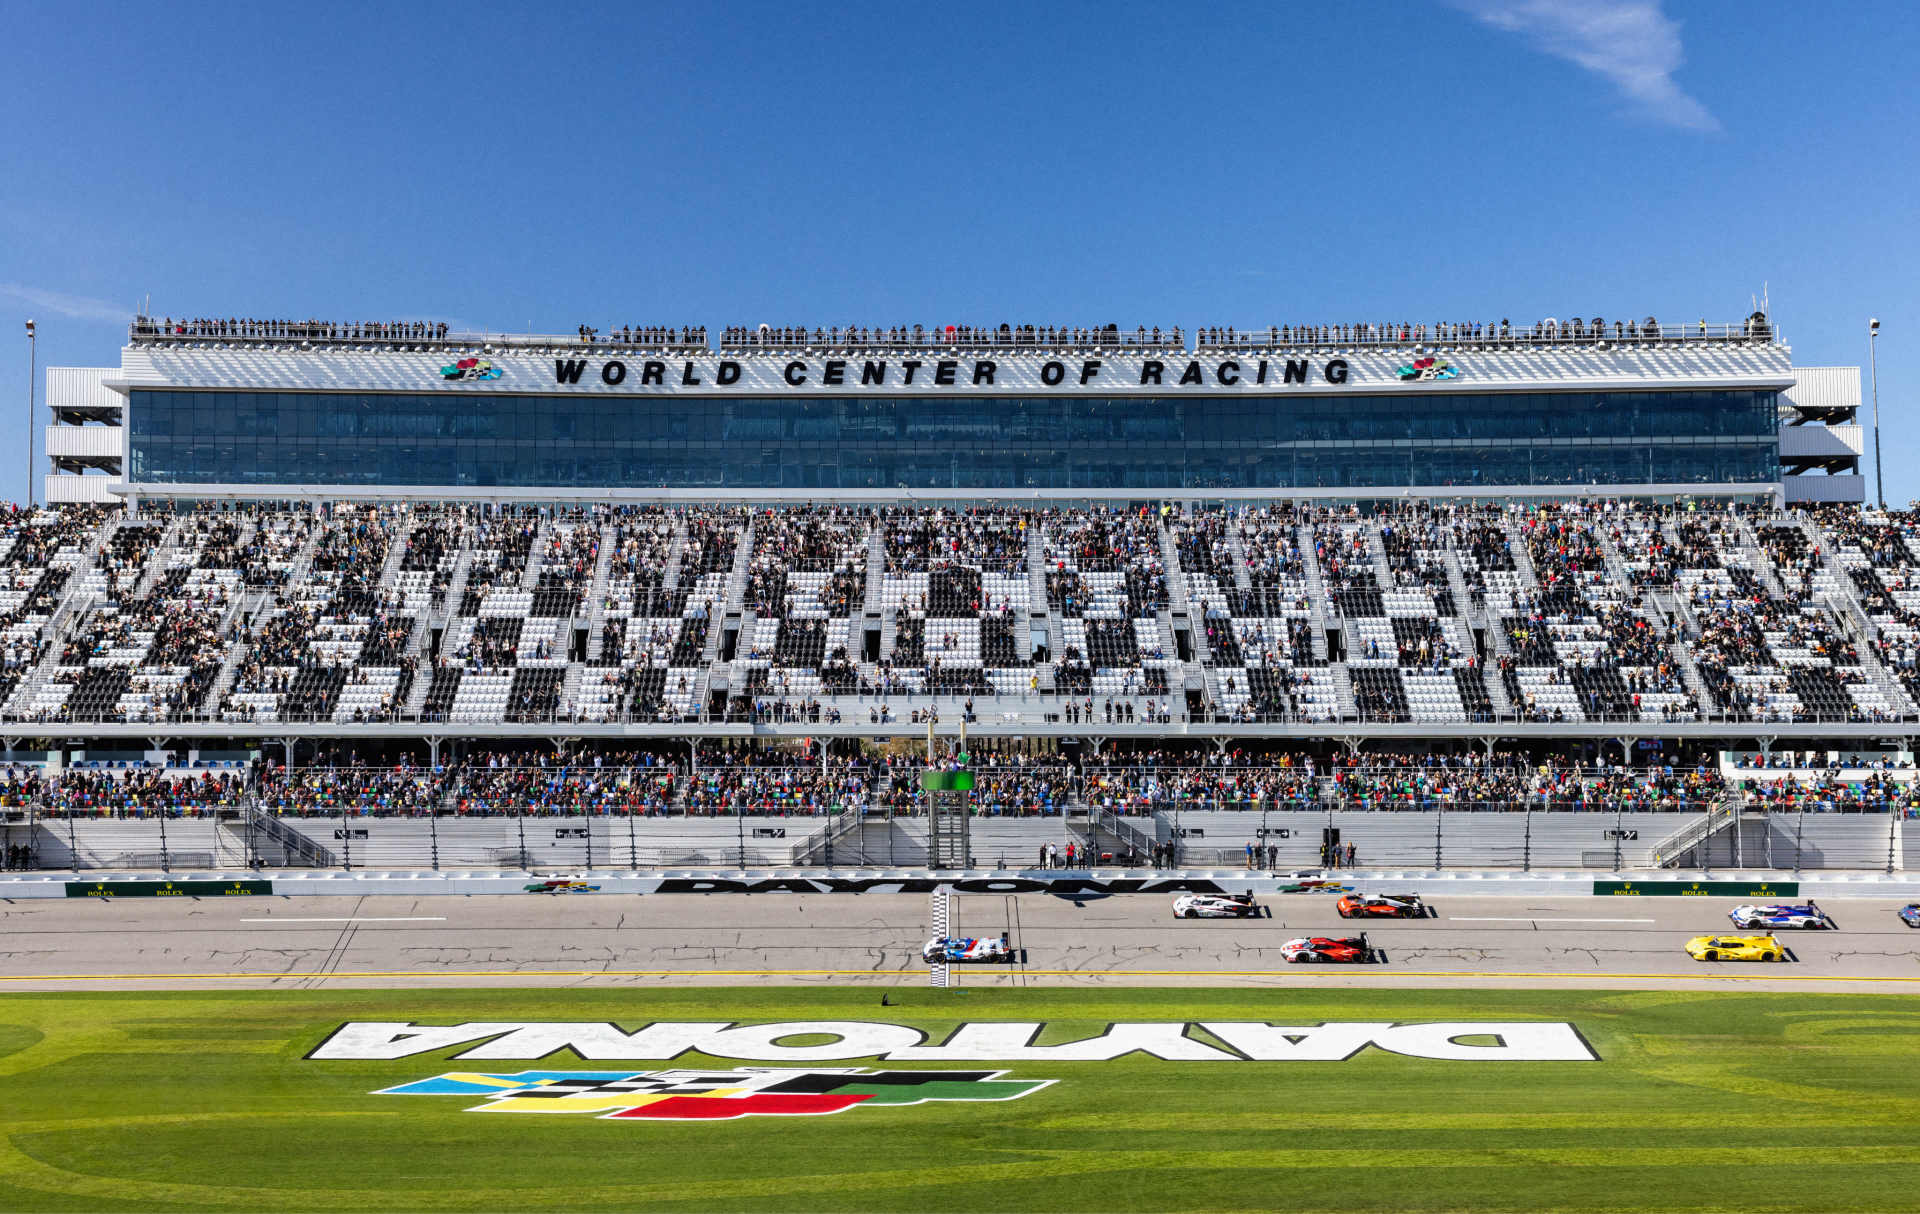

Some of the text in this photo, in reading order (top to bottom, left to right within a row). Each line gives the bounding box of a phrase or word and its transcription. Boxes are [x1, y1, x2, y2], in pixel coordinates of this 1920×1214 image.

[555, 359, 1348, 386] WORLD CENTER OF RACING
[156, 889, 183, 897] ROLEX
[654, 879, 1226, 894] DAYTONA
[303, 1021, 1602, 1061] DAYTONA
